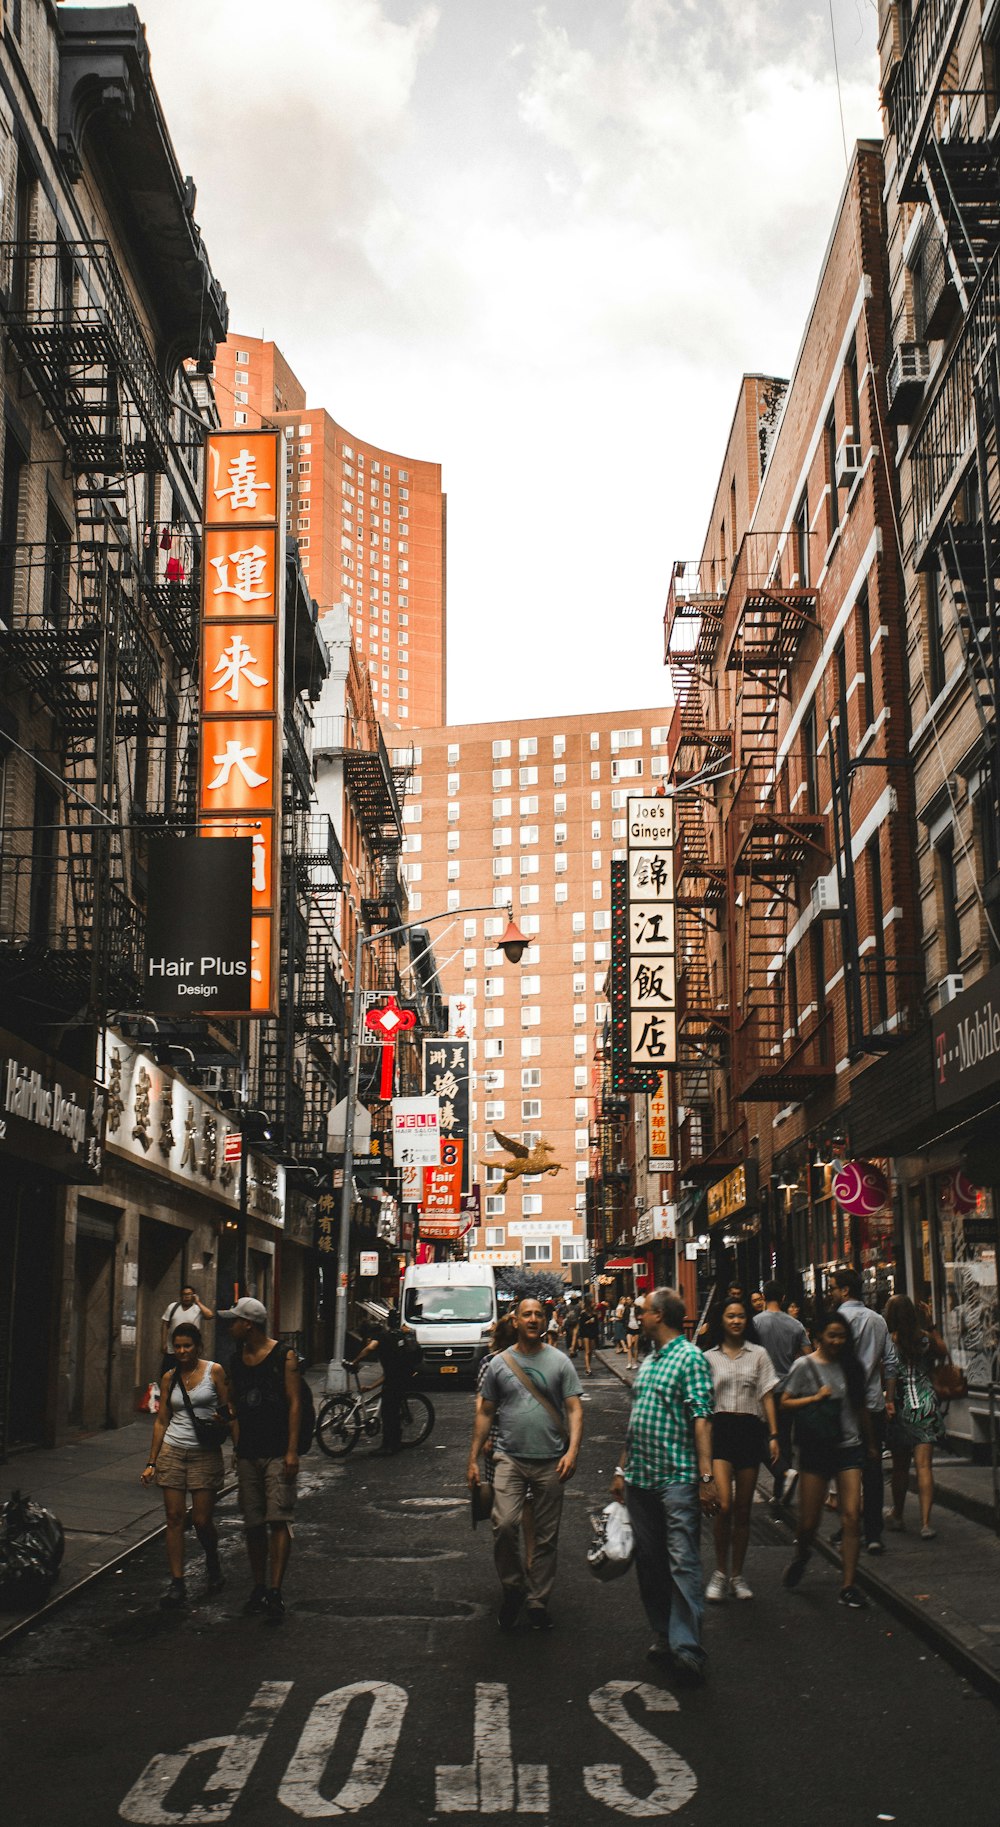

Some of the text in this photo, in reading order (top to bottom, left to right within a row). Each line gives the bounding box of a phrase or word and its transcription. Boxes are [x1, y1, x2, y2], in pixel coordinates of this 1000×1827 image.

[207, 449, 272, 983] 喜運來大
[636, 803, 665, 818] Joe's
[631, 822, 671, 841] Ginger
[632, 853, 673, 1059] 錦江飯店
[148, 957, 248, 977] Hair Plus
[177, 983, 218, 998] Design
[52, 1083, 86, 1154] Design
[396, 1115, 437, 1128] PELL
[431, 1183, 449, 1193] Le
[427, 1195, 454, 1206] Pell
[118, 1680, 698, 1825] STOP
